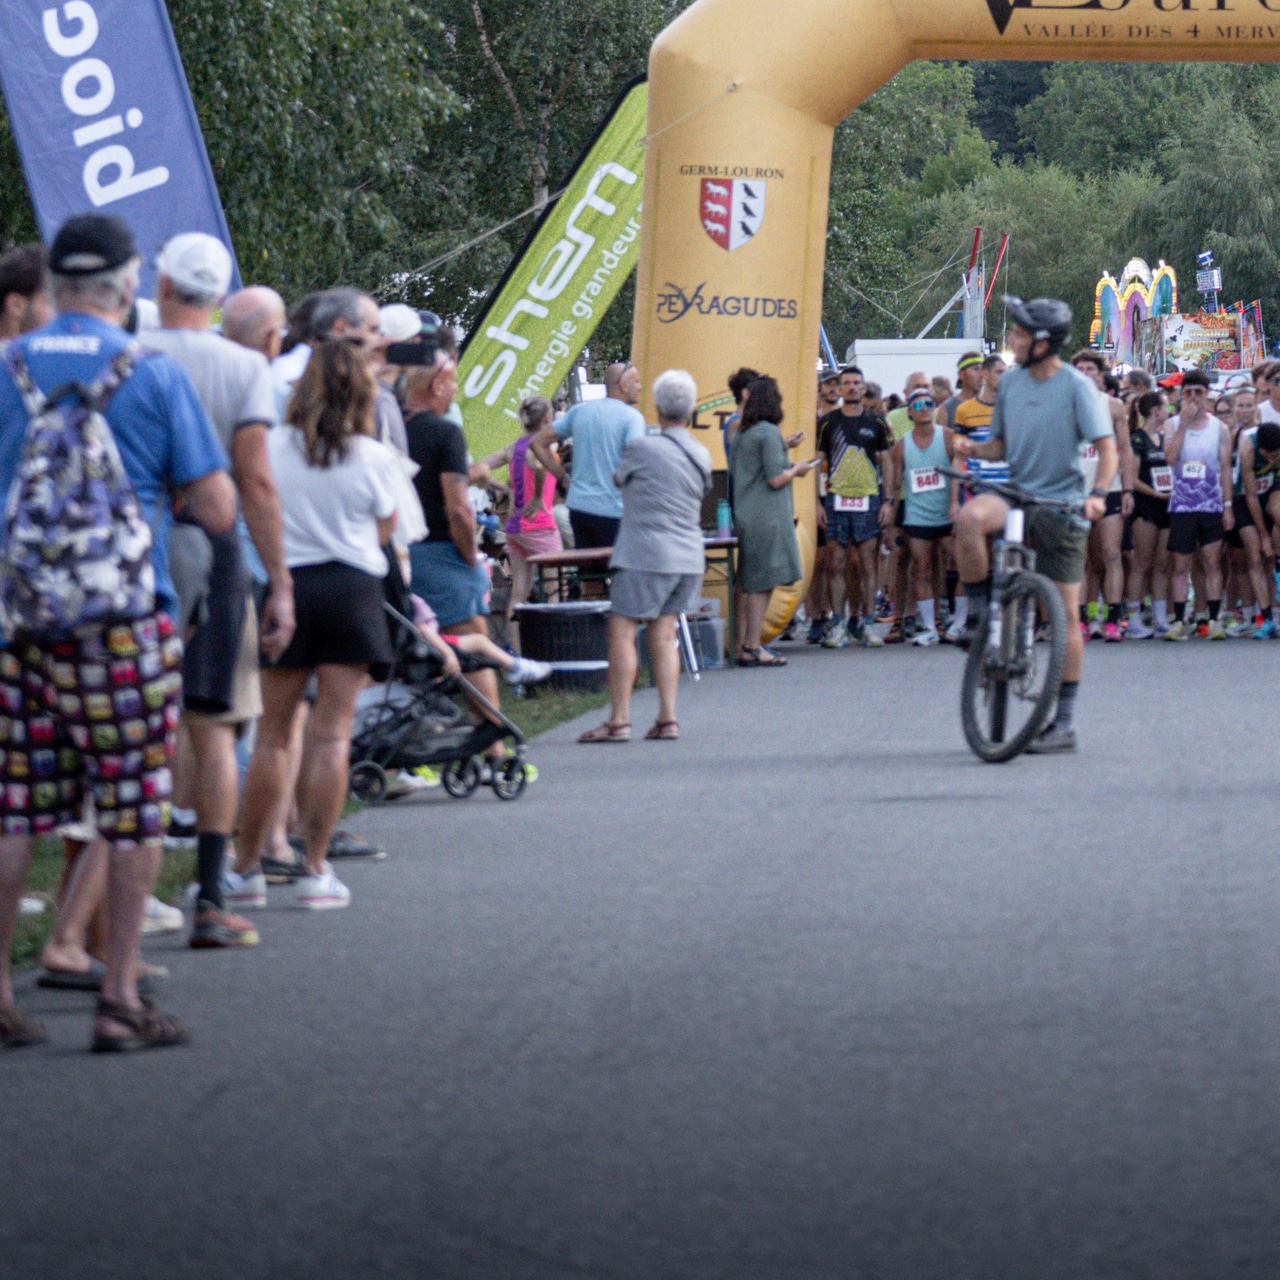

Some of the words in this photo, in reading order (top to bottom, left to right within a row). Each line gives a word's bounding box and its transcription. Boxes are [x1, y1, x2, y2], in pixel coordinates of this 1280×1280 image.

[1022, 22, 1116, 39] VALLÉE
[1128, 25, 1173, 39] DES
[1185, 25, 1201, 39] 4
[679, 164, 785, 180] GERM-LOURON
[464, 161, 637, 406] shem
[656, 281, 798, 324] PEYRAGUDES
[916, 473, 940, 488] 840
